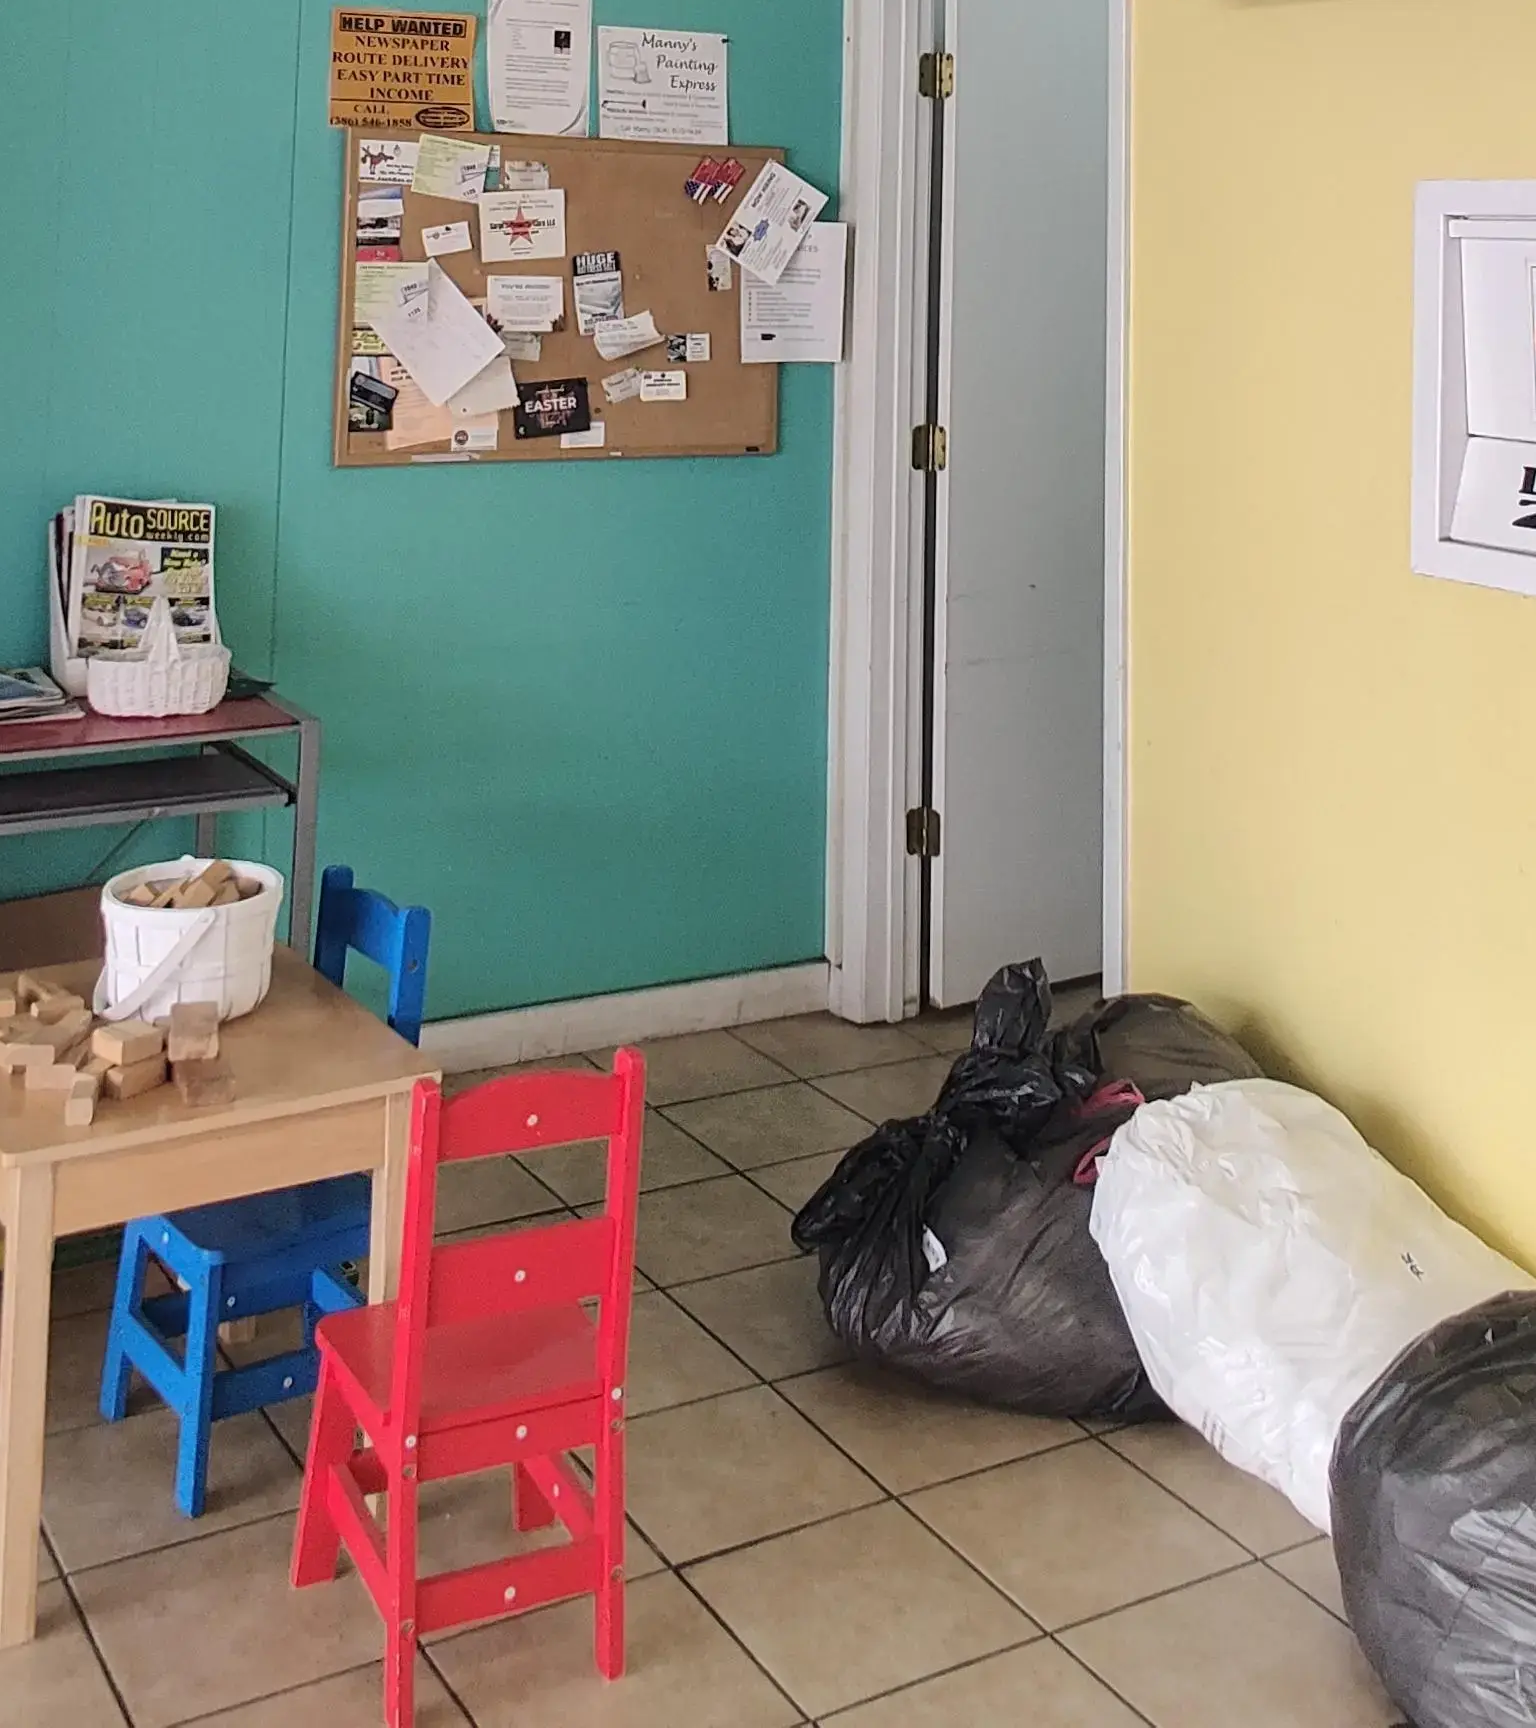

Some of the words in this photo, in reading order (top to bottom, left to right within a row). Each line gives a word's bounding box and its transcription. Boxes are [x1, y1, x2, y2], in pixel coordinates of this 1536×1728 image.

[342, 17, 385, 31] HELP
[392, 19, 464, 35] WANTED
[355, 36, 450, 51] NEWSPAPER
[641, 32, 697, 52] Manny's
[333, 51, 387, 65] ROUTE
[392, 55, 470, 69] DELIVERY
[656, 55, 717, 73] Painting
[337, 69, 379, 81] EASY
[383, 70, 423, 84] PART
[426, 73, 465, 86] TIME
[670, 75, 716, 92] Express
[370, 87, 433, 101] INCOME
[354, 104, 389, 114] CALL
[576, 252, 615, 266] HUGE
[525, 396, 576, 413] EASTER
[90, 502, 144, 538] Auto
[147, 509, 210, 531] SOURCE
